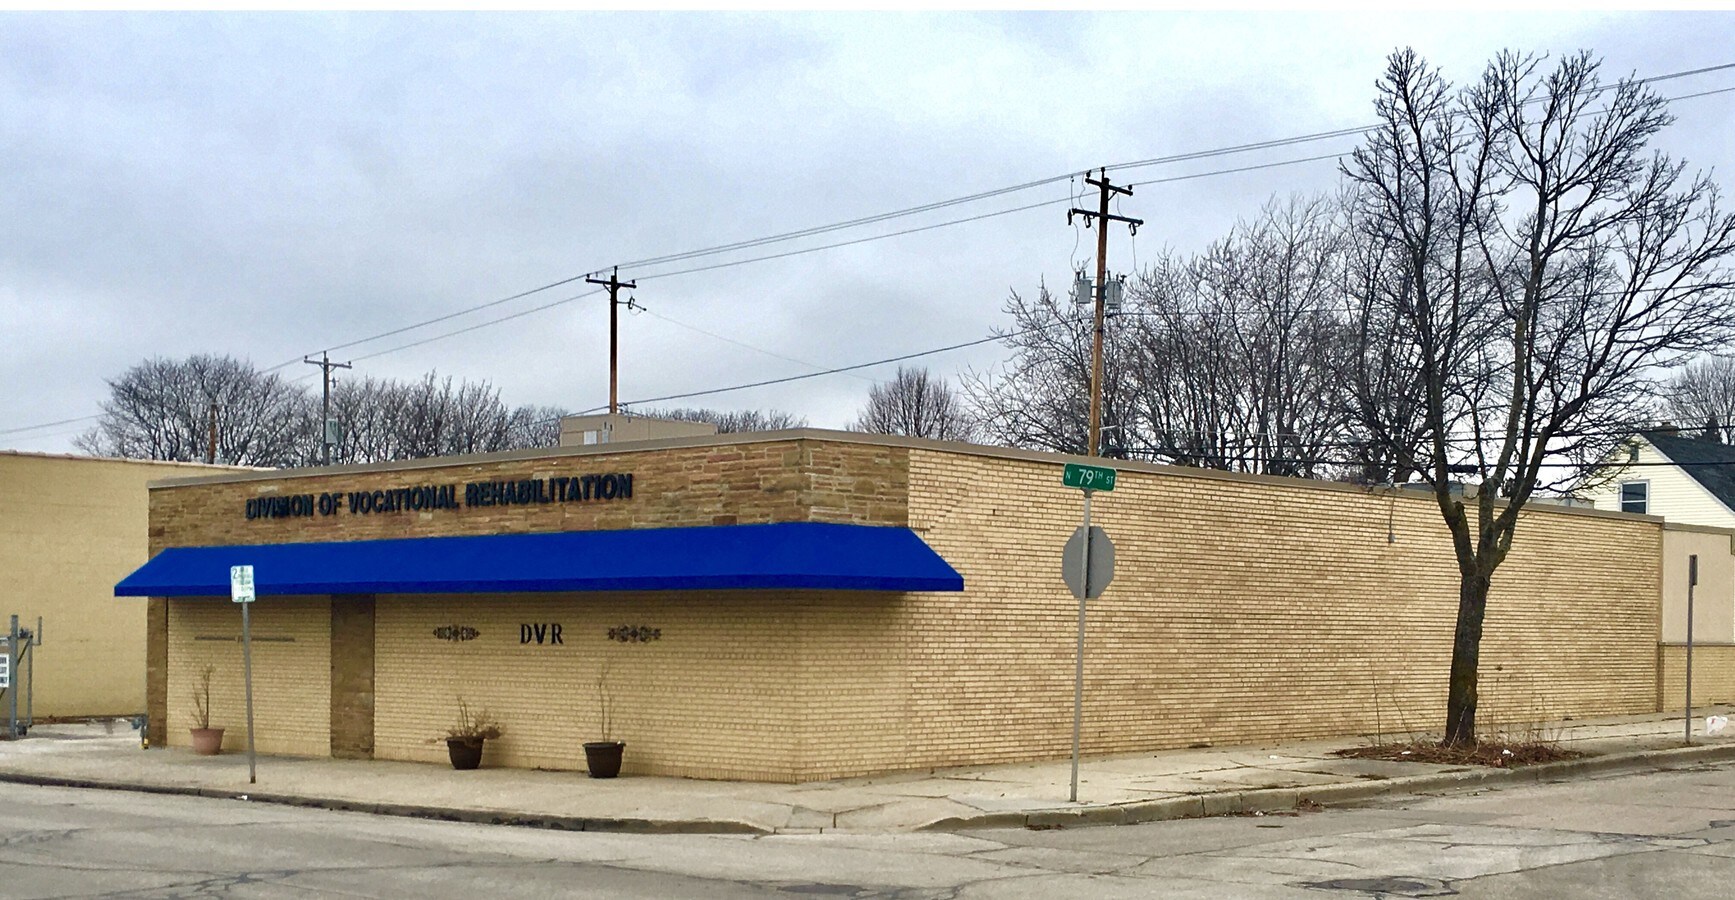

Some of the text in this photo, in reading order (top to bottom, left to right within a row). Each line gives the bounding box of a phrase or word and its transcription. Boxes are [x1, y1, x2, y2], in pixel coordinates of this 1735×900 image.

[1066, 471, 1071, 479] N
[1106, 476, 1113, 484] ST
[246, 473, 633, 520] DIVISION OF VOCATIONAL REHABILITATION
[520, 623, 564, 645] DVR
